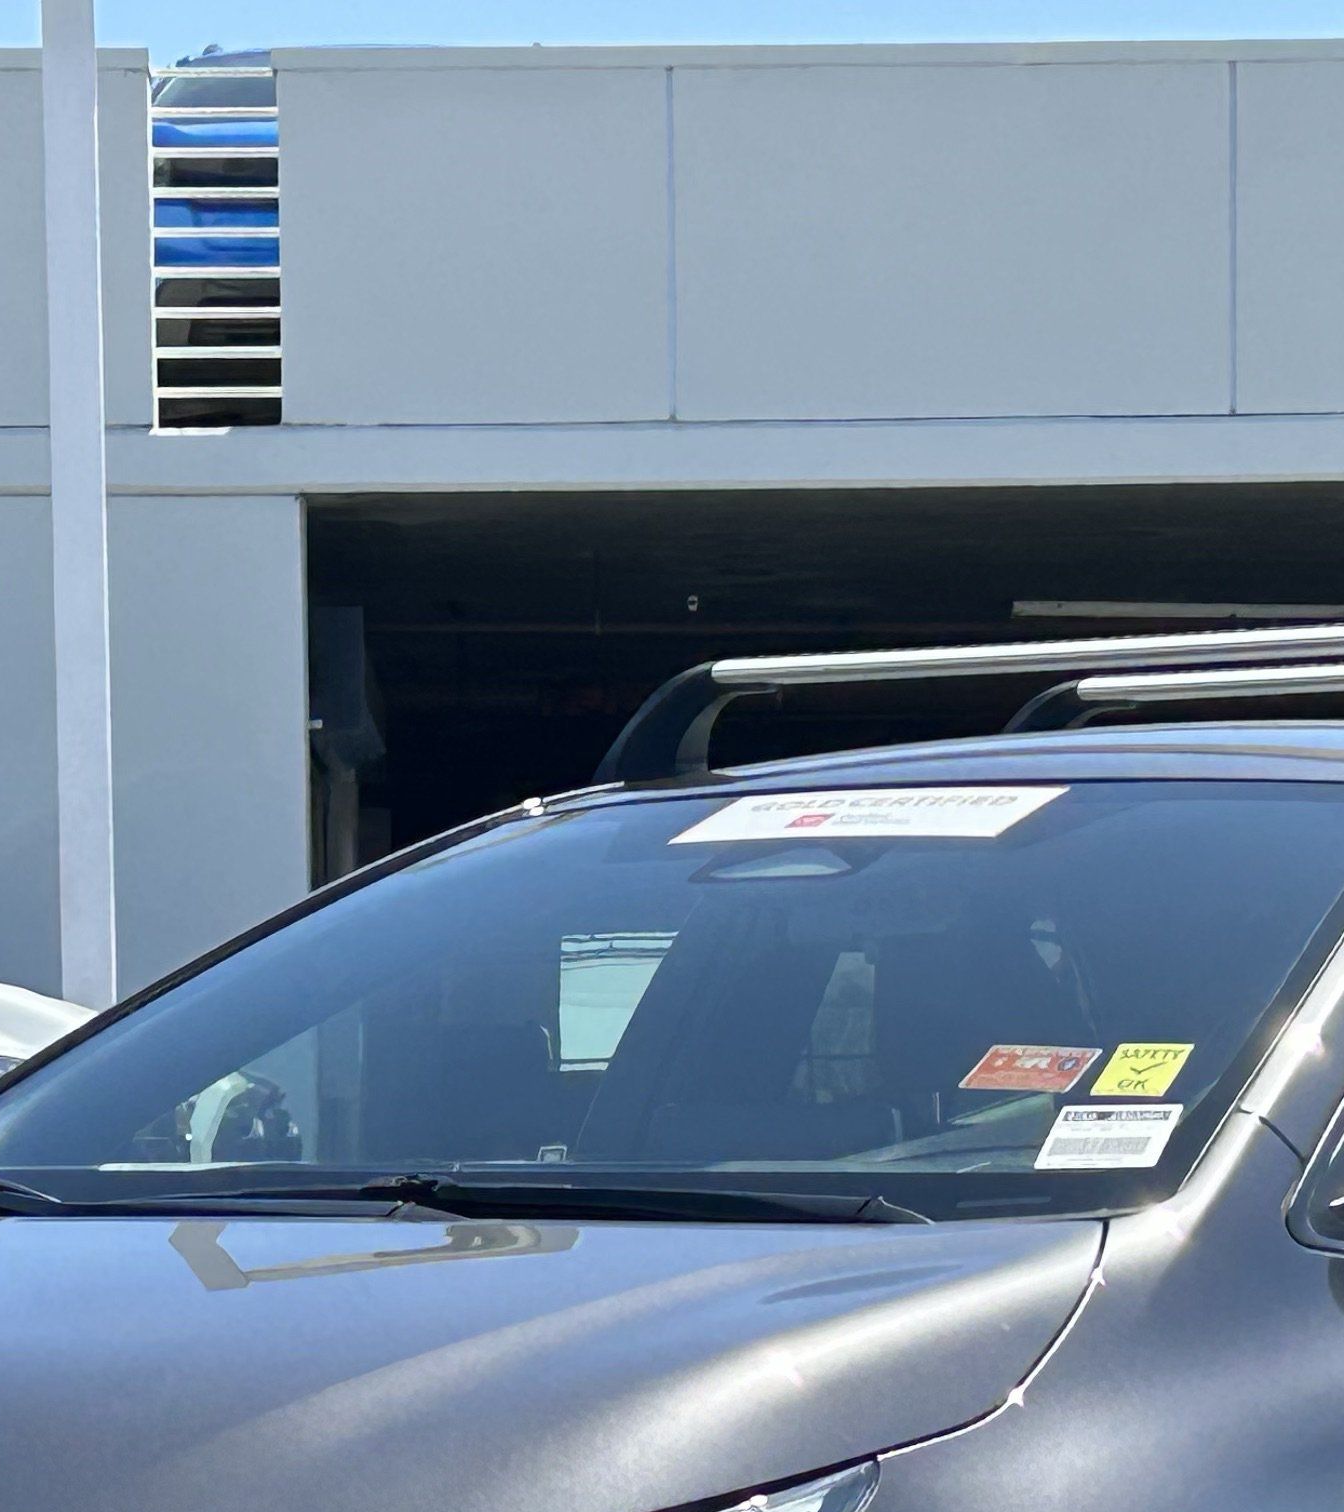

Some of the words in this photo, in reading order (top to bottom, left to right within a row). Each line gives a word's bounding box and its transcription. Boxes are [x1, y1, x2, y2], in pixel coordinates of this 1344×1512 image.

[751, 799, 846, 812] GOLD
[848, 795, 1018, 808] CERTIFIED
[1117, 1078, 1150, 1091] OK
